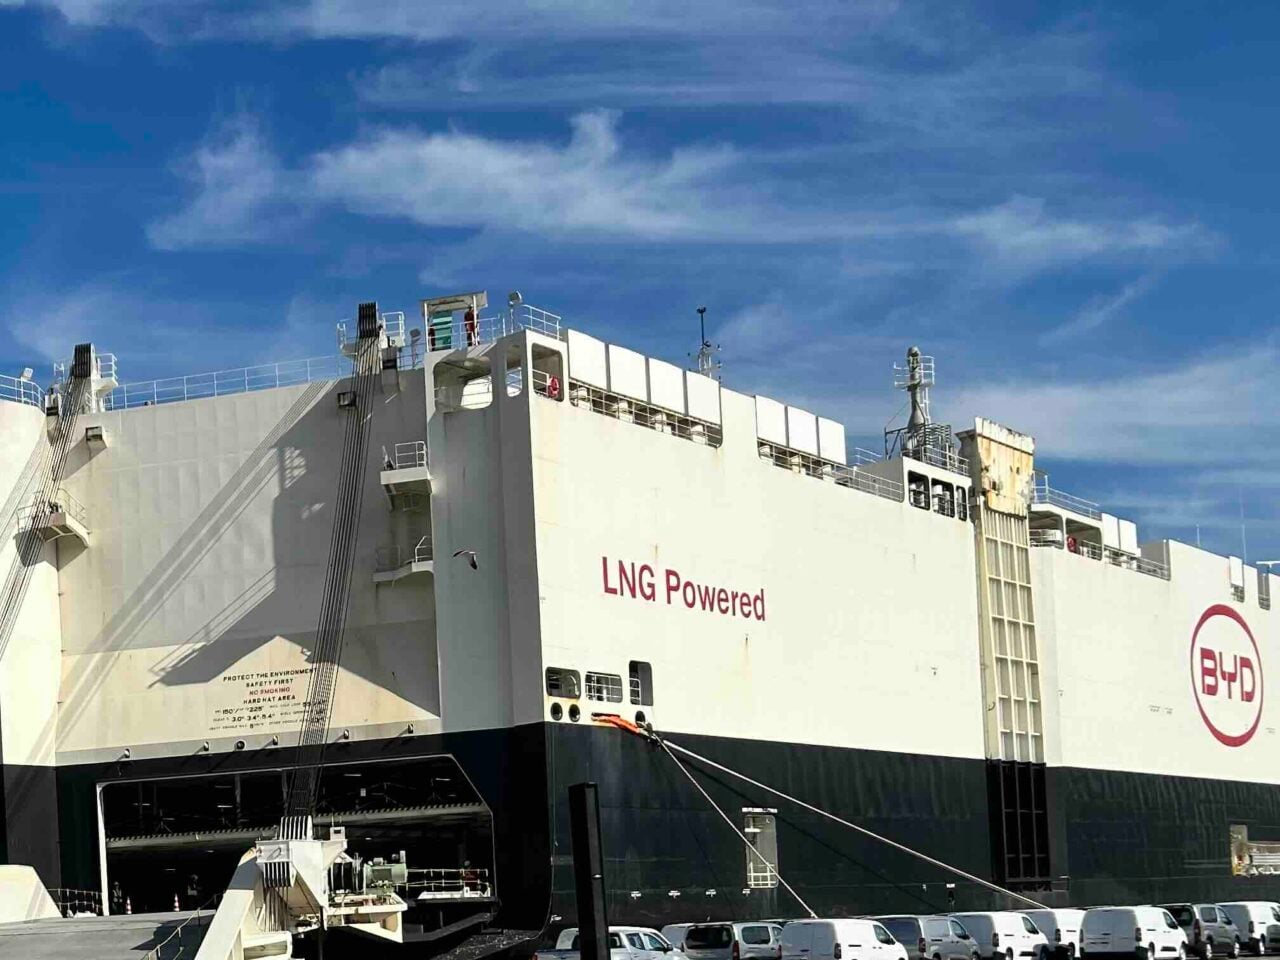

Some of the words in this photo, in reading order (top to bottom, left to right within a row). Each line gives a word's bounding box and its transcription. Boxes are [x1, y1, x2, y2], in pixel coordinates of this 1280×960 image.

[602, 556, 656, 602] LNG
[665, 569, 766, 621] Powered
[223, 673, 255, 682] PROTECT
[1200, 647, 1256, 702] BYD
[246, 680, 273, 688] SAFETY
[249, 688, 259, 696] NO
[260, 686, 291, 695] SMOKING
[243, 697, 261, 705] HARD
[262, 696, 275, 704] HAT
[278, 694, 296, 702] AREA
